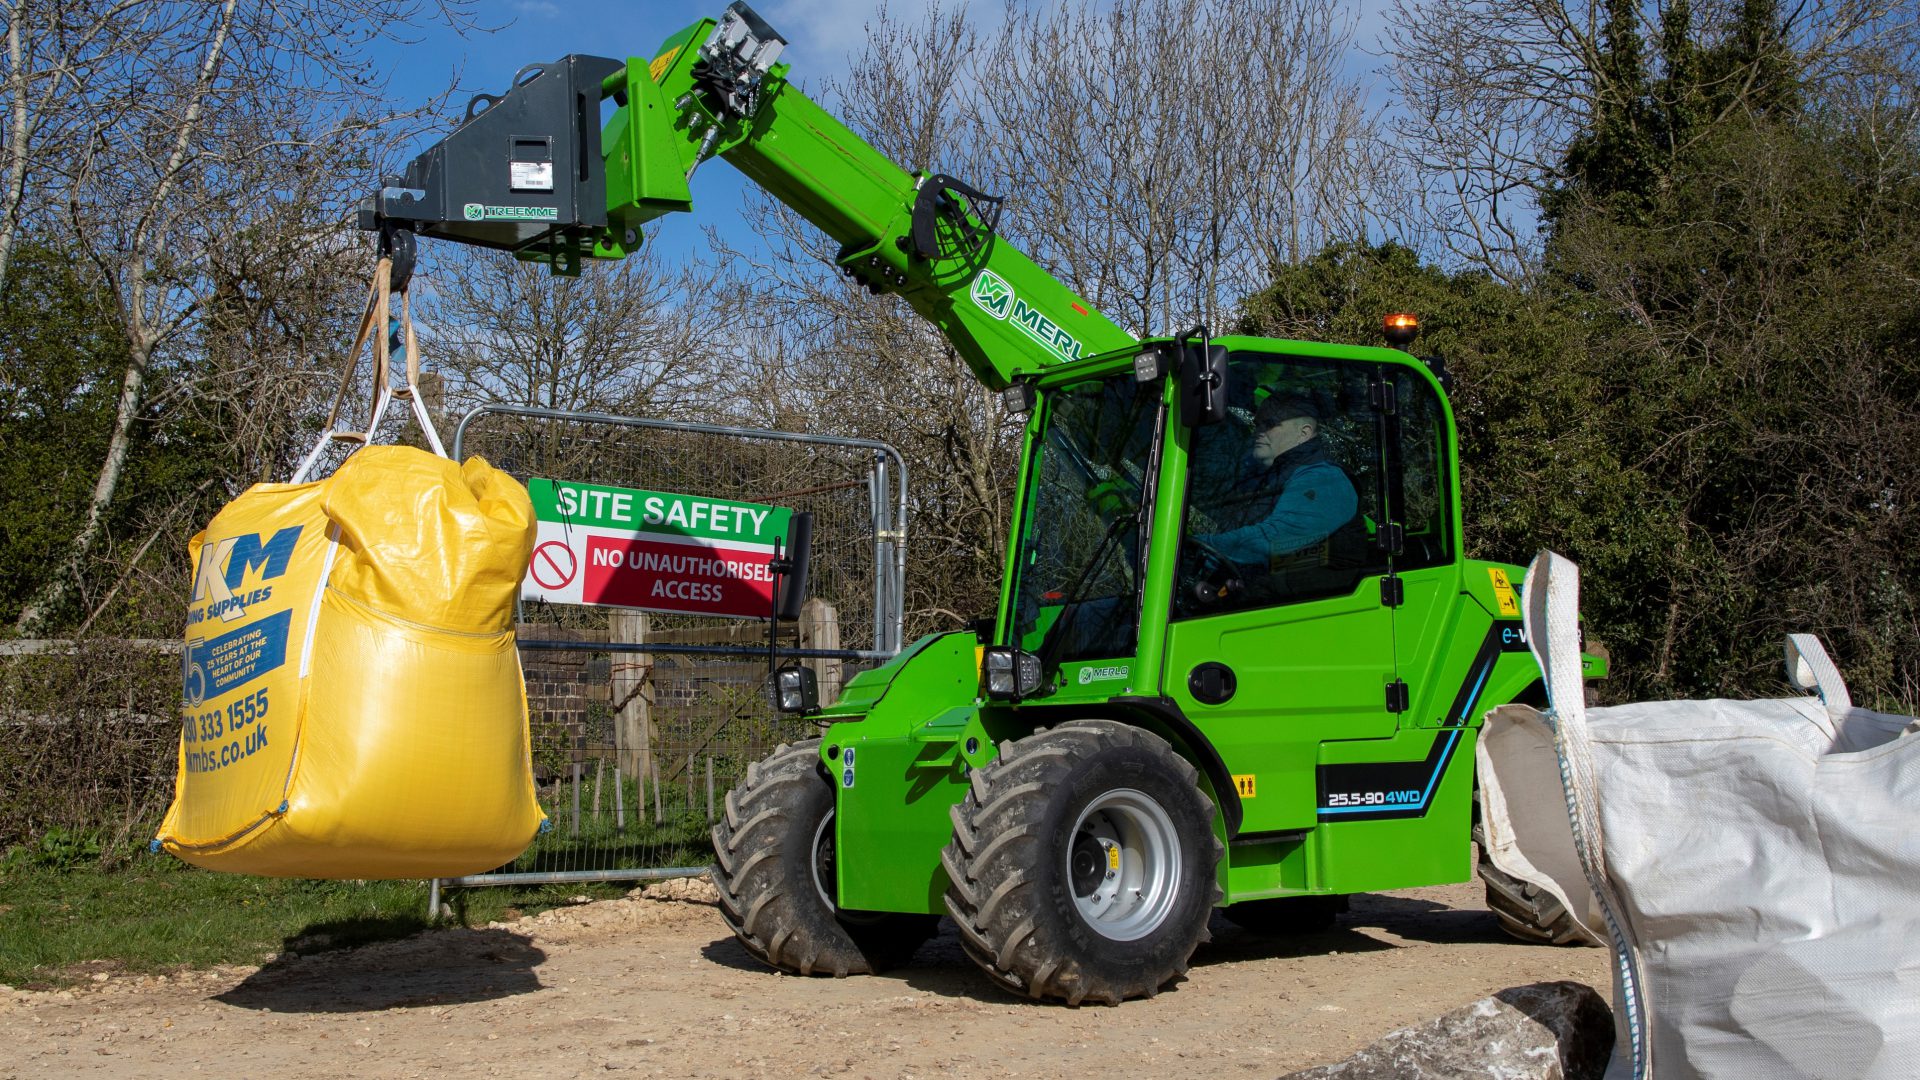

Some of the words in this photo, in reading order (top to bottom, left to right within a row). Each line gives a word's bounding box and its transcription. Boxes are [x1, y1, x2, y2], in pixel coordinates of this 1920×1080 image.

[485, 206, 558, 217] TREEMME
[1012, 298, 1095, 361] MERL
[555, 487, 633, 522] SITE
[643, 496, 769, 536] SAFETY
[592, 547, 624, 568] NO
[629, 551, 774, 582] UNAUTHORISED
[207, 586, 273, 620] SUPPLIES
[651, 579, 723, 602] ACCESS
[207, 660, 215, 670] 25
[215, 650, 238, 667] YEARS
[239, 645, 250, 656] AT
[250, 636, 268, 652] THE
[212, 629, 261, 657] CELEBRATING
[212, 662, 233, 679] HEART
[233, 657, 244, 669] OF
[244, 649, 261, 664] OUR
[215, 662, 256, 688] COMMUNITY
[1093, 666, 1128, 677] MERLO
[199, 709, 223, 741] 333
[226, 686, 268, 732] 1555
[186, 722, 268, 773] kmbs.co.uk
[1328, 792, 1384, 806] 25.5-90
[1385, 790, 1420, 803] 4WD
